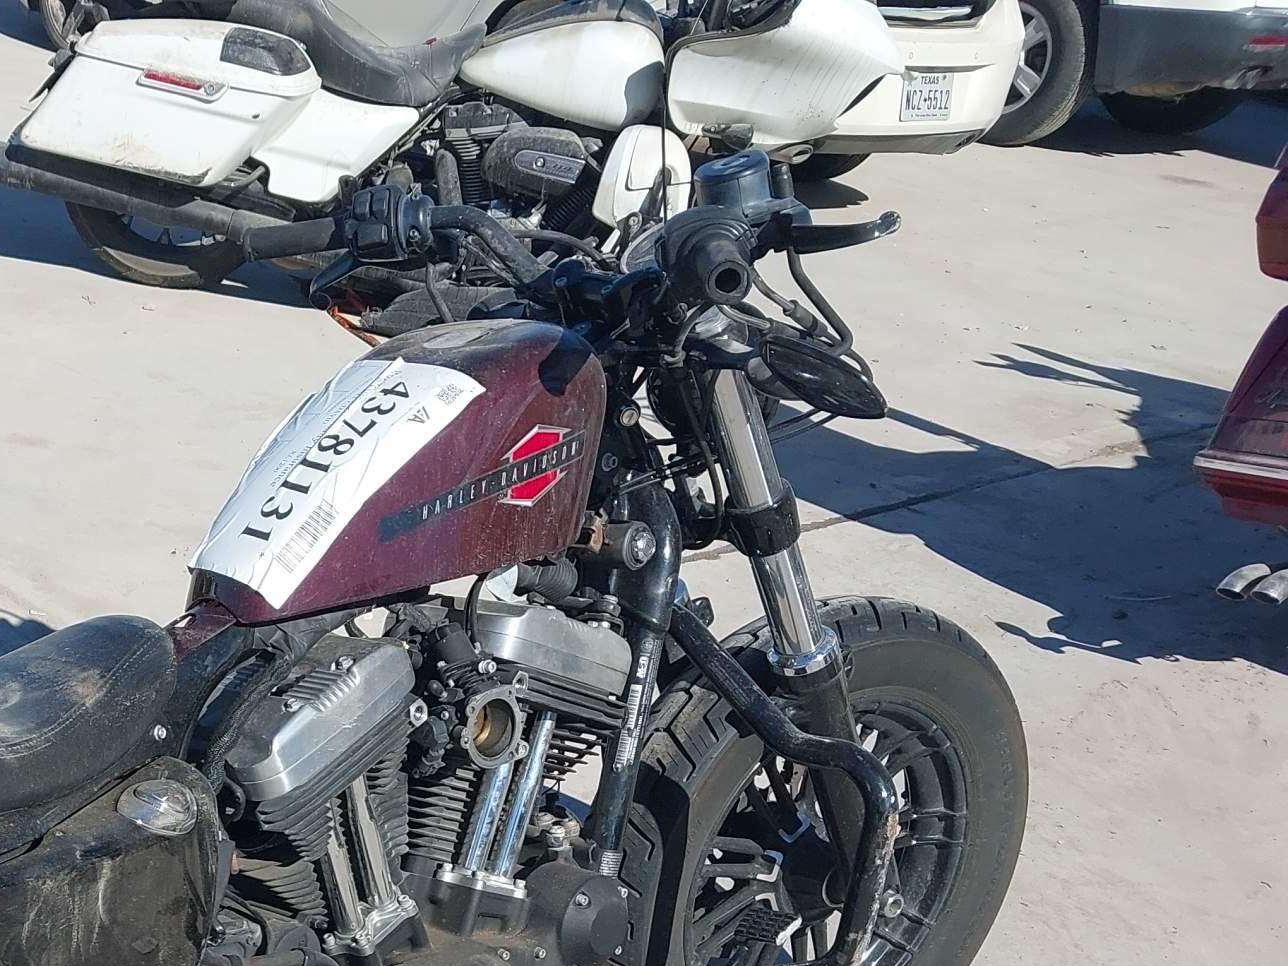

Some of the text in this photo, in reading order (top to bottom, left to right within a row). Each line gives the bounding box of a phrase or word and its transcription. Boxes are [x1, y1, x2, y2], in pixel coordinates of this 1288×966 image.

[920, 75, 940, 85] TEXAS
[239, 381, 410, 542] 43781131
[422, 440, 577, 521] HARLEY-DAVIDSON
